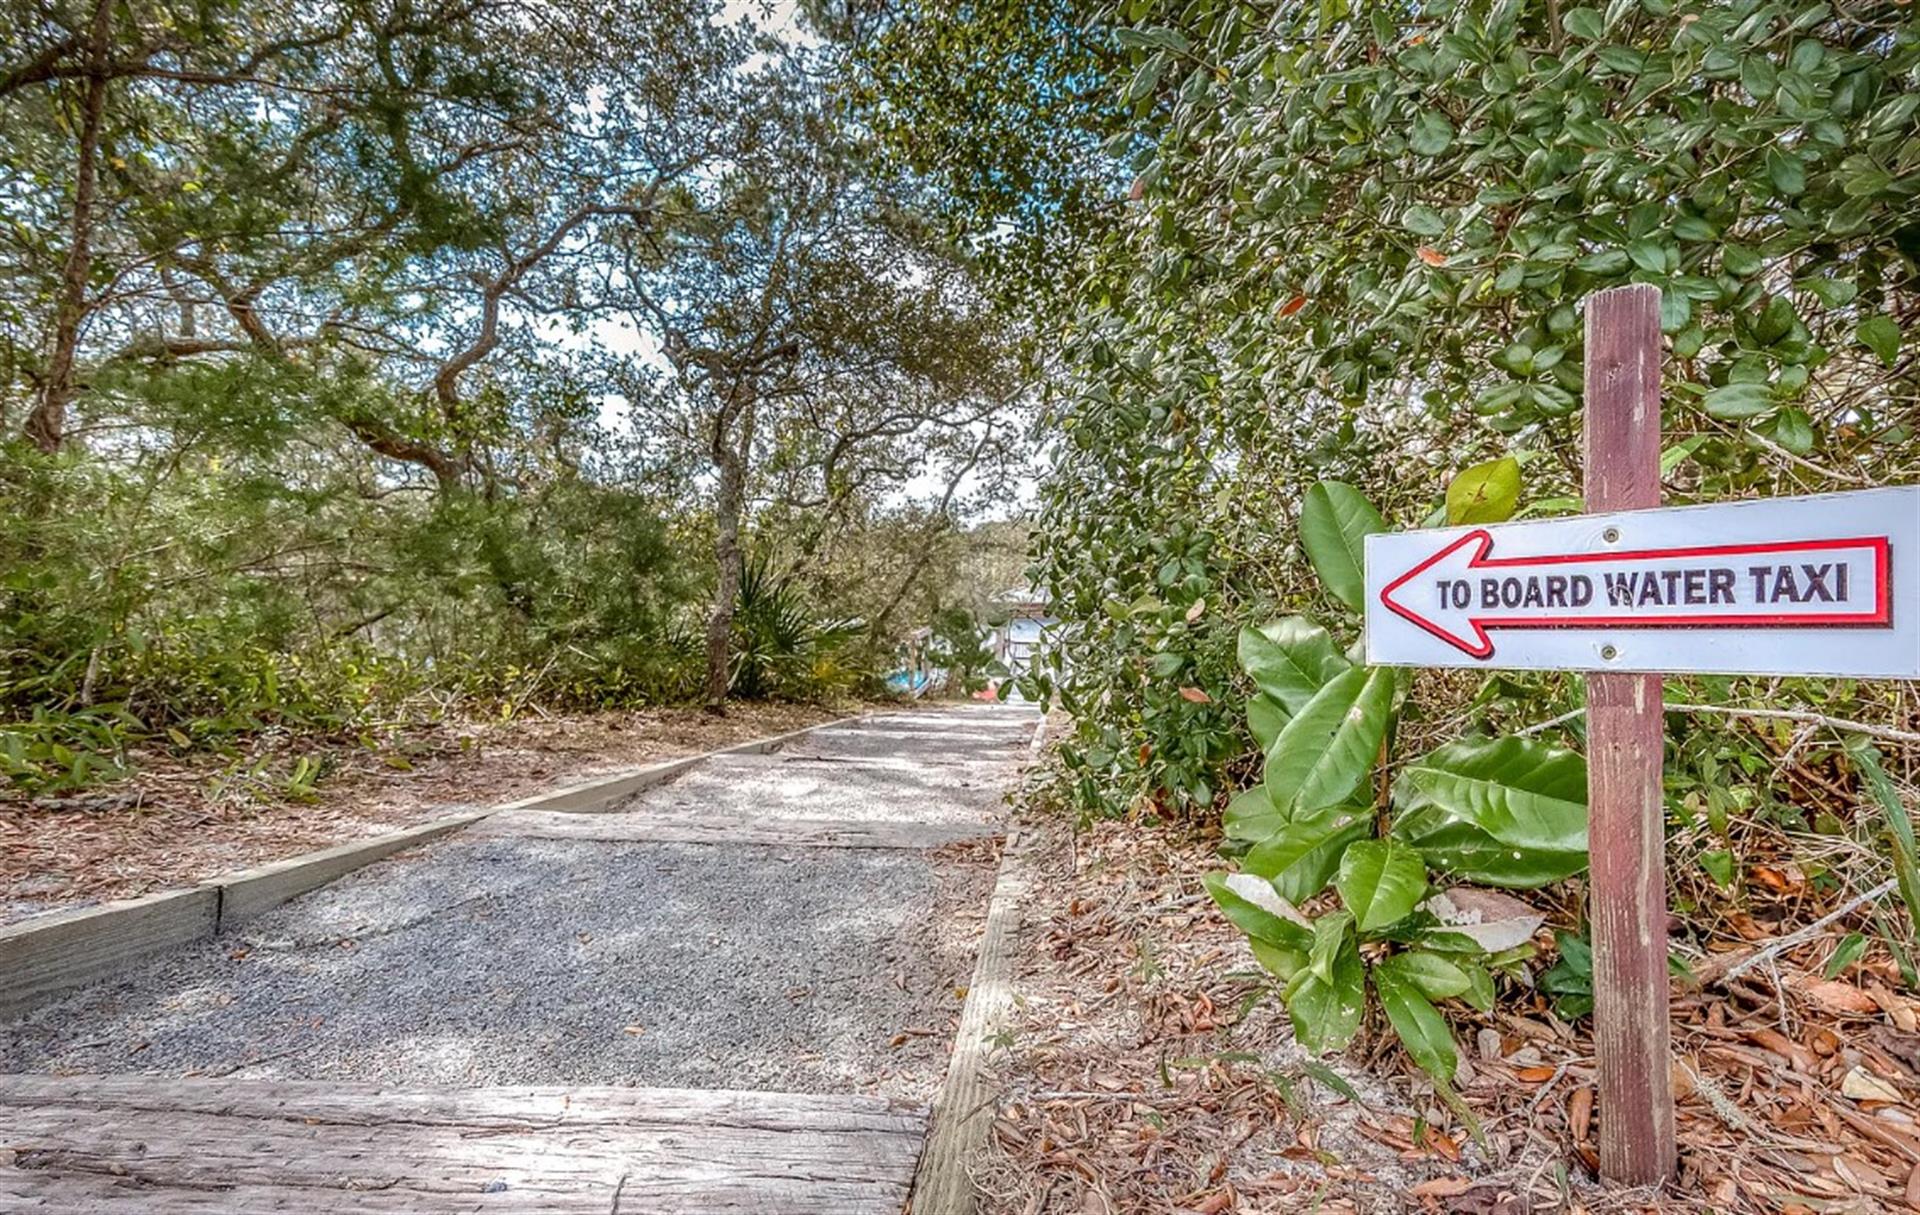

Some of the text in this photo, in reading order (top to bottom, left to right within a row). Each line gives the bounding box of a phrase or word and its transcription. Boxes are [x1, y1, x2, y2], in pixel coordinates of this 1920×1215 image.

[1436, 562, 1847, 610] TO BOARD WATER TAXI
